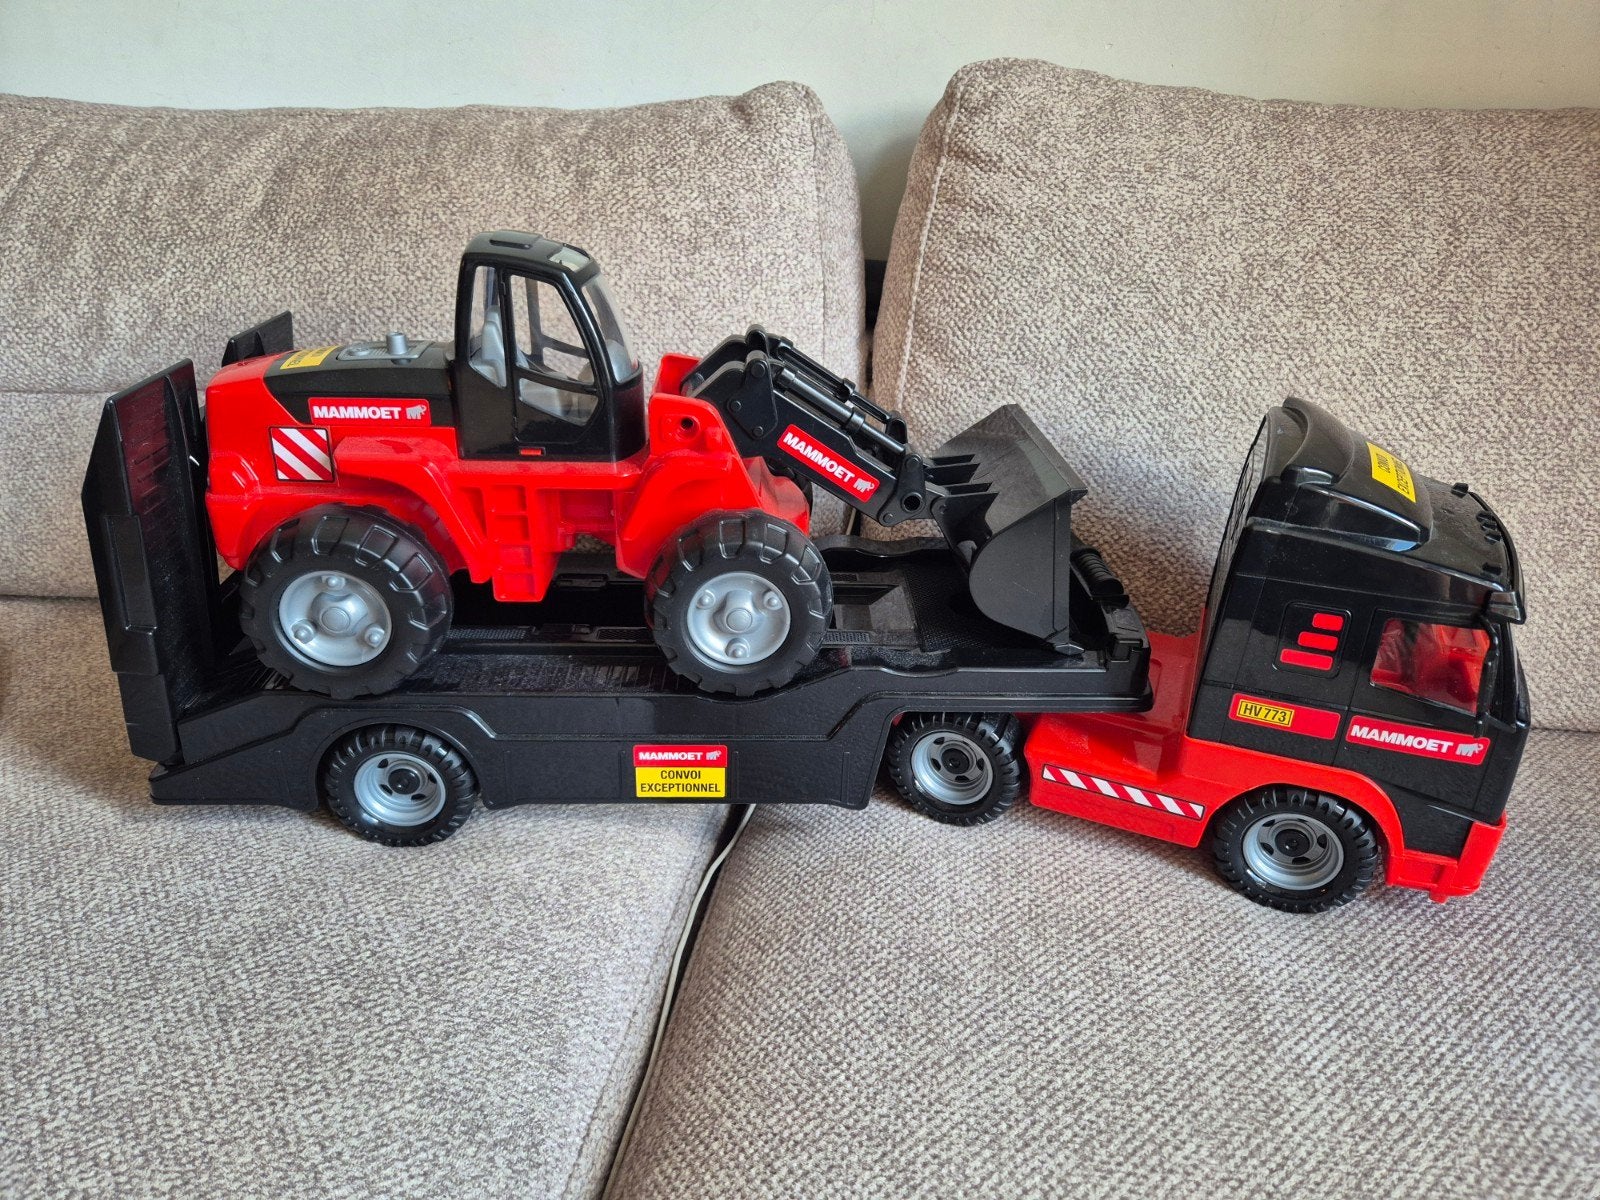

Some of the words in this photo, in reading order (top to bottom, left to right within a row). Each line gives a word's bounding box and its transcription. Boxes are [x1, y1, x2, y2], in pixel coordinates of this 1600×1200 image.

[312, 405, 402, 420] MAMMOET
[783, 432, 856, 483] MAMMOET
[1350, 724, 1454, 754] MAMMOET
[638, 751, 704, 761] MAMMOET
[660, 770, 701, 780] CONVOI
[640, 783, 722, 793] EXCEPTIONNEL
